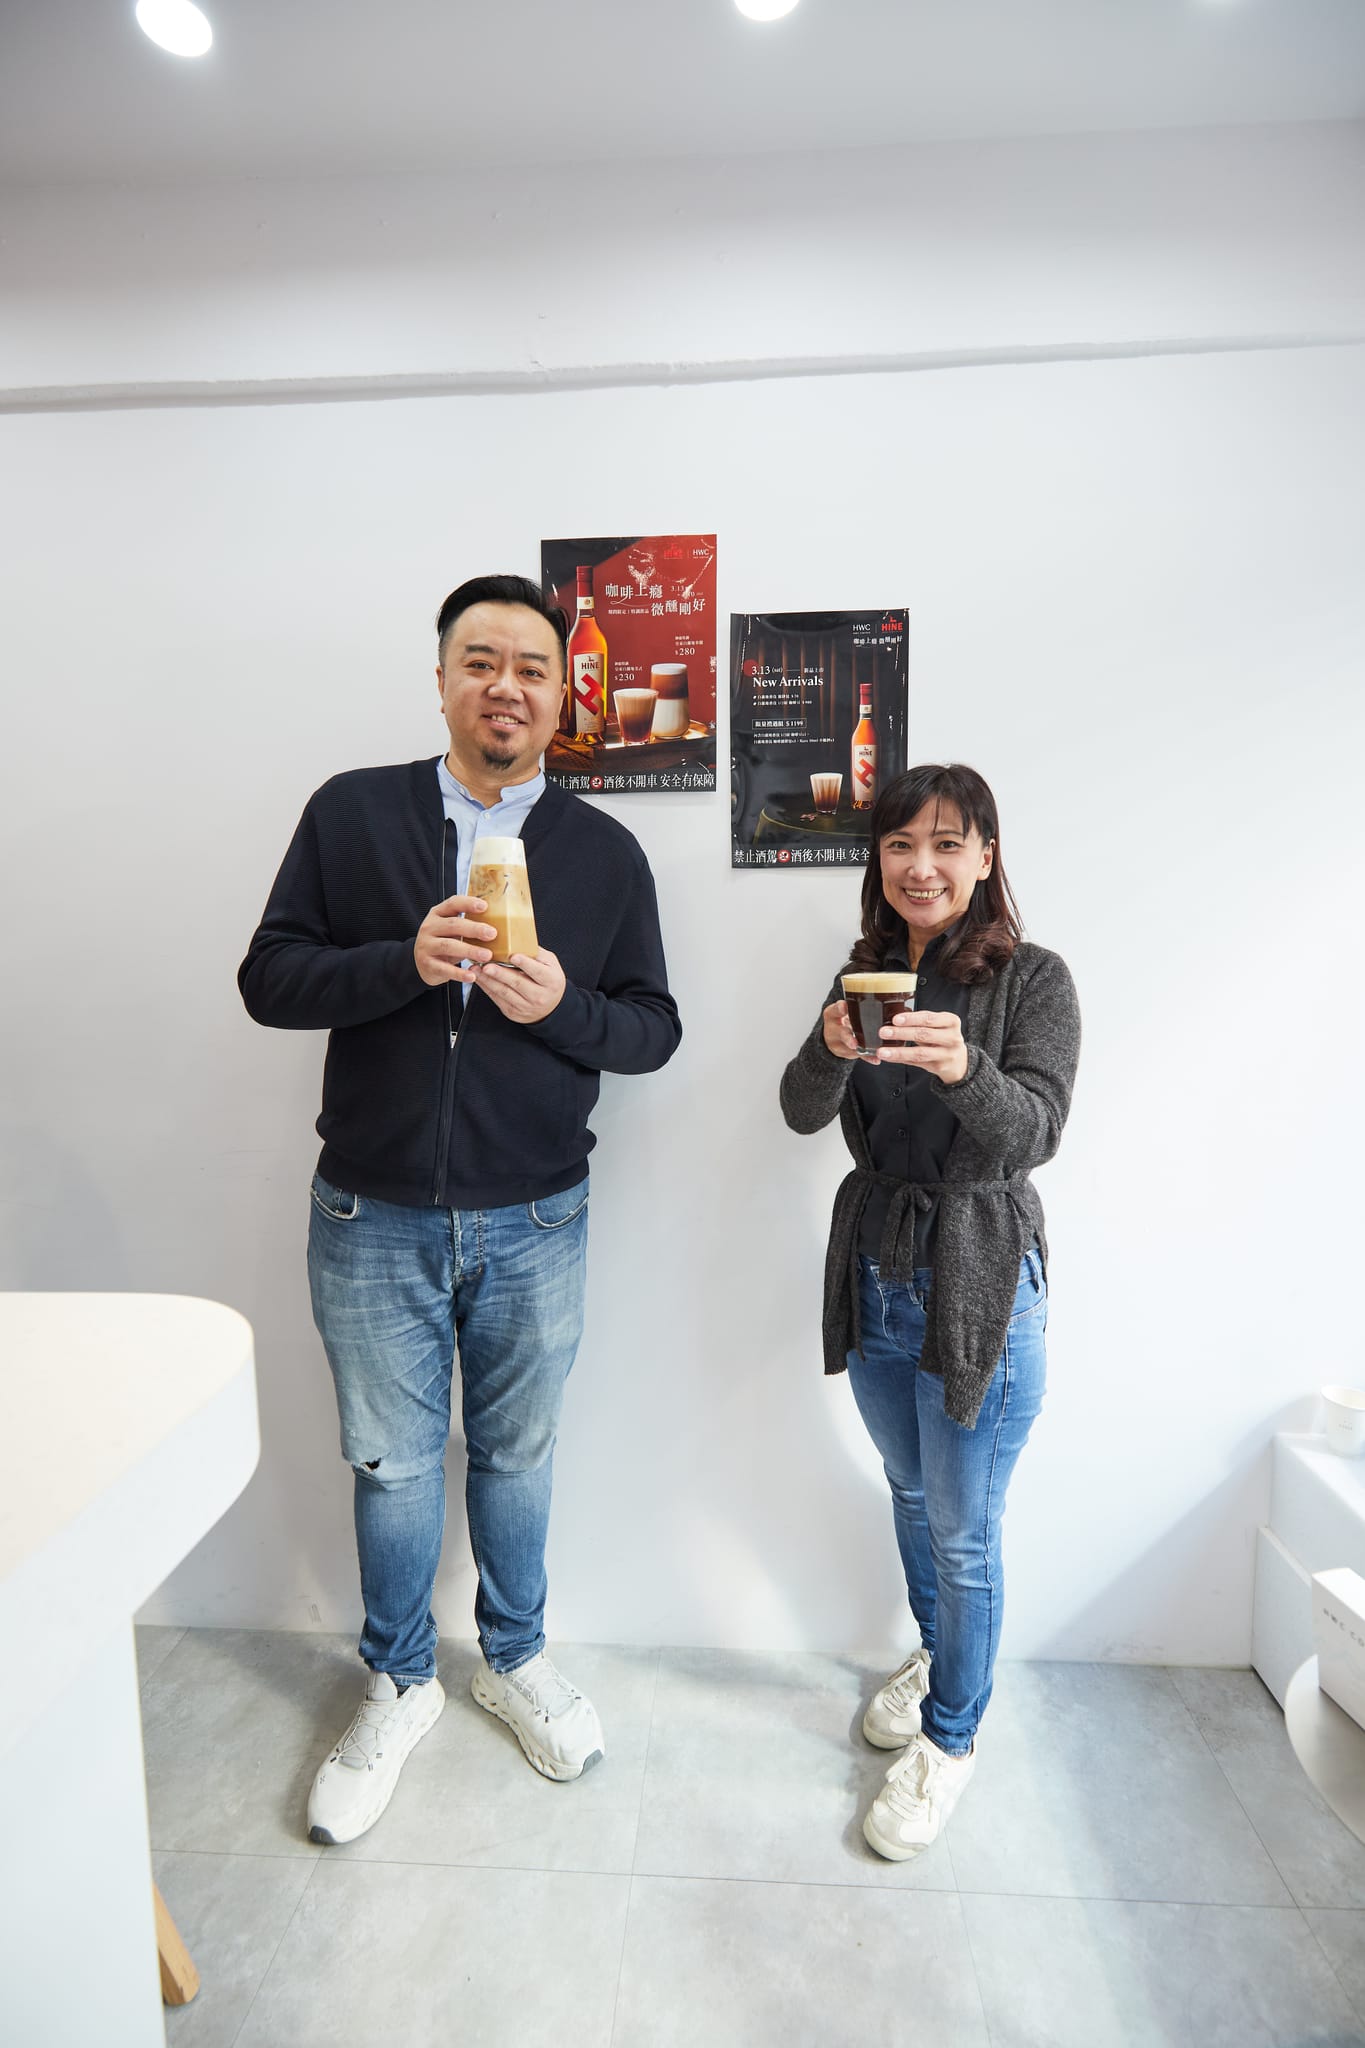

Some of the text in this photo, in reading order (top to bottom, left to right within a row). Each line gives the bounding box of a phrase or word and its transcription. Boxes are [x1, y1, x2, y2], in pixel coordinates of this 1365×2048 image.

[605, 583, 663, 599] 咖啡上癮
[651, 598, 706, 616] 微醺剛好
[881, 622, 903, 632] HINE
[581, 662, 600, 670] HINE
[751, 666, 771, 675] 3.13
[752, 675, 824, 688] New Arrivals
[603, 774, 657, 789] 酒後不開車
[659, 773, 715, 788] 安全有保障
[734, 849, 777, 863] 禁止酒駕
[791, 848, 847, 862] 酒後不開車
